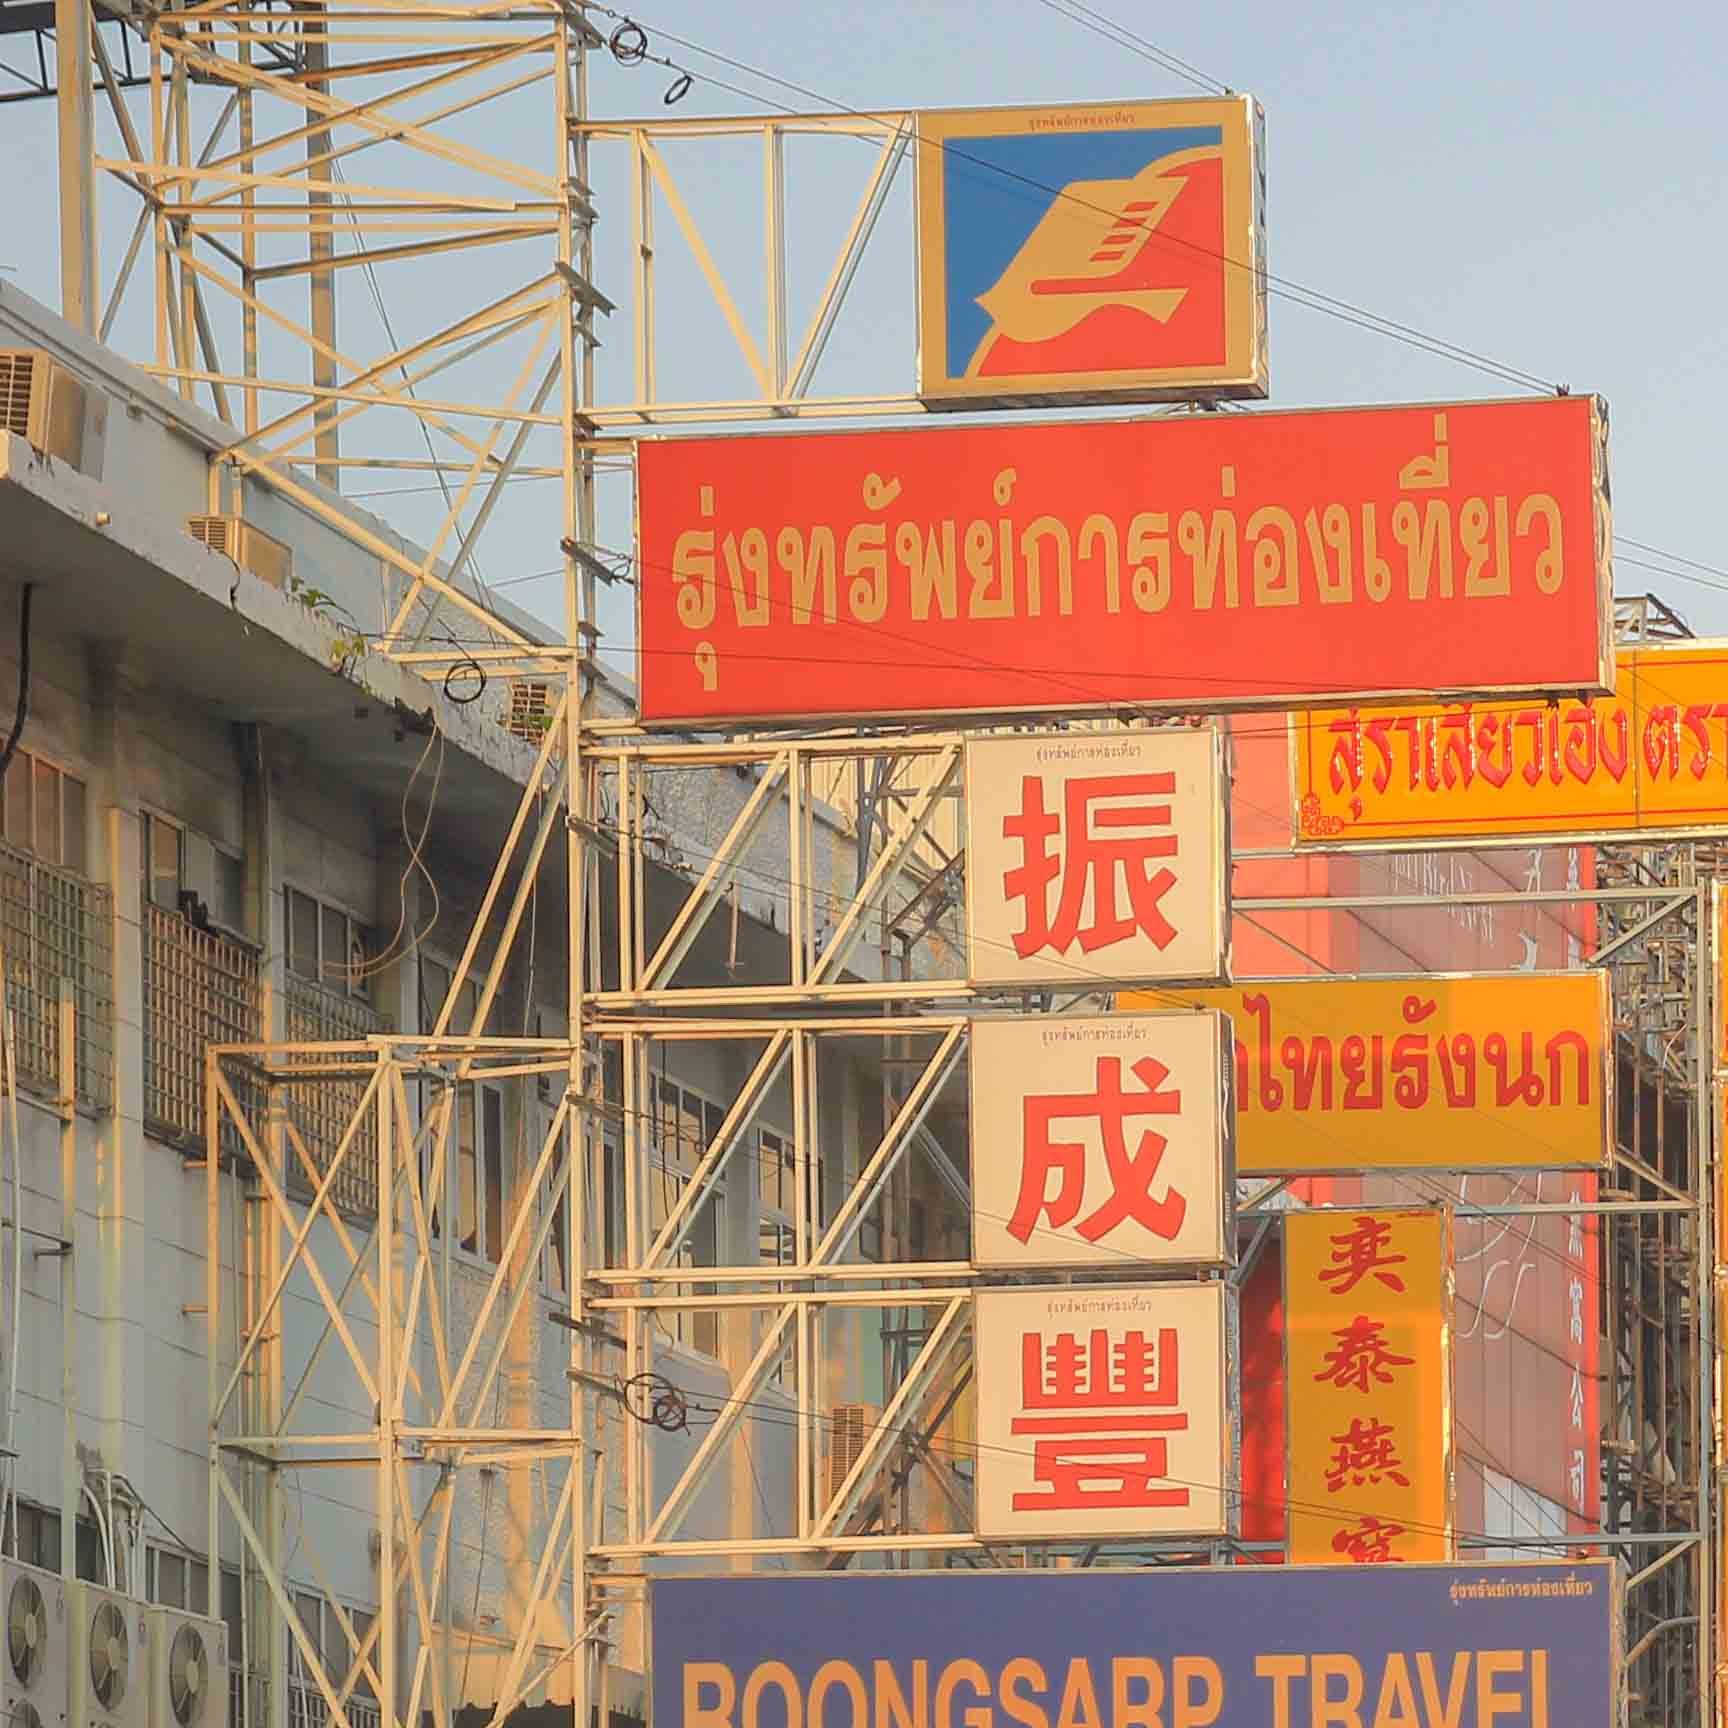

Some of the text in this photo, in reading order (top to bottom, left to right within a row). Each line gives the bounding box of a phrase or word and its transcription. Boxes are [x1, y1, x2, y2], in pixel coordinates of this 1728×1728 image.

[670, 412, 1565, 691] รุ่งทรัพย์การท่องเที่ยว
